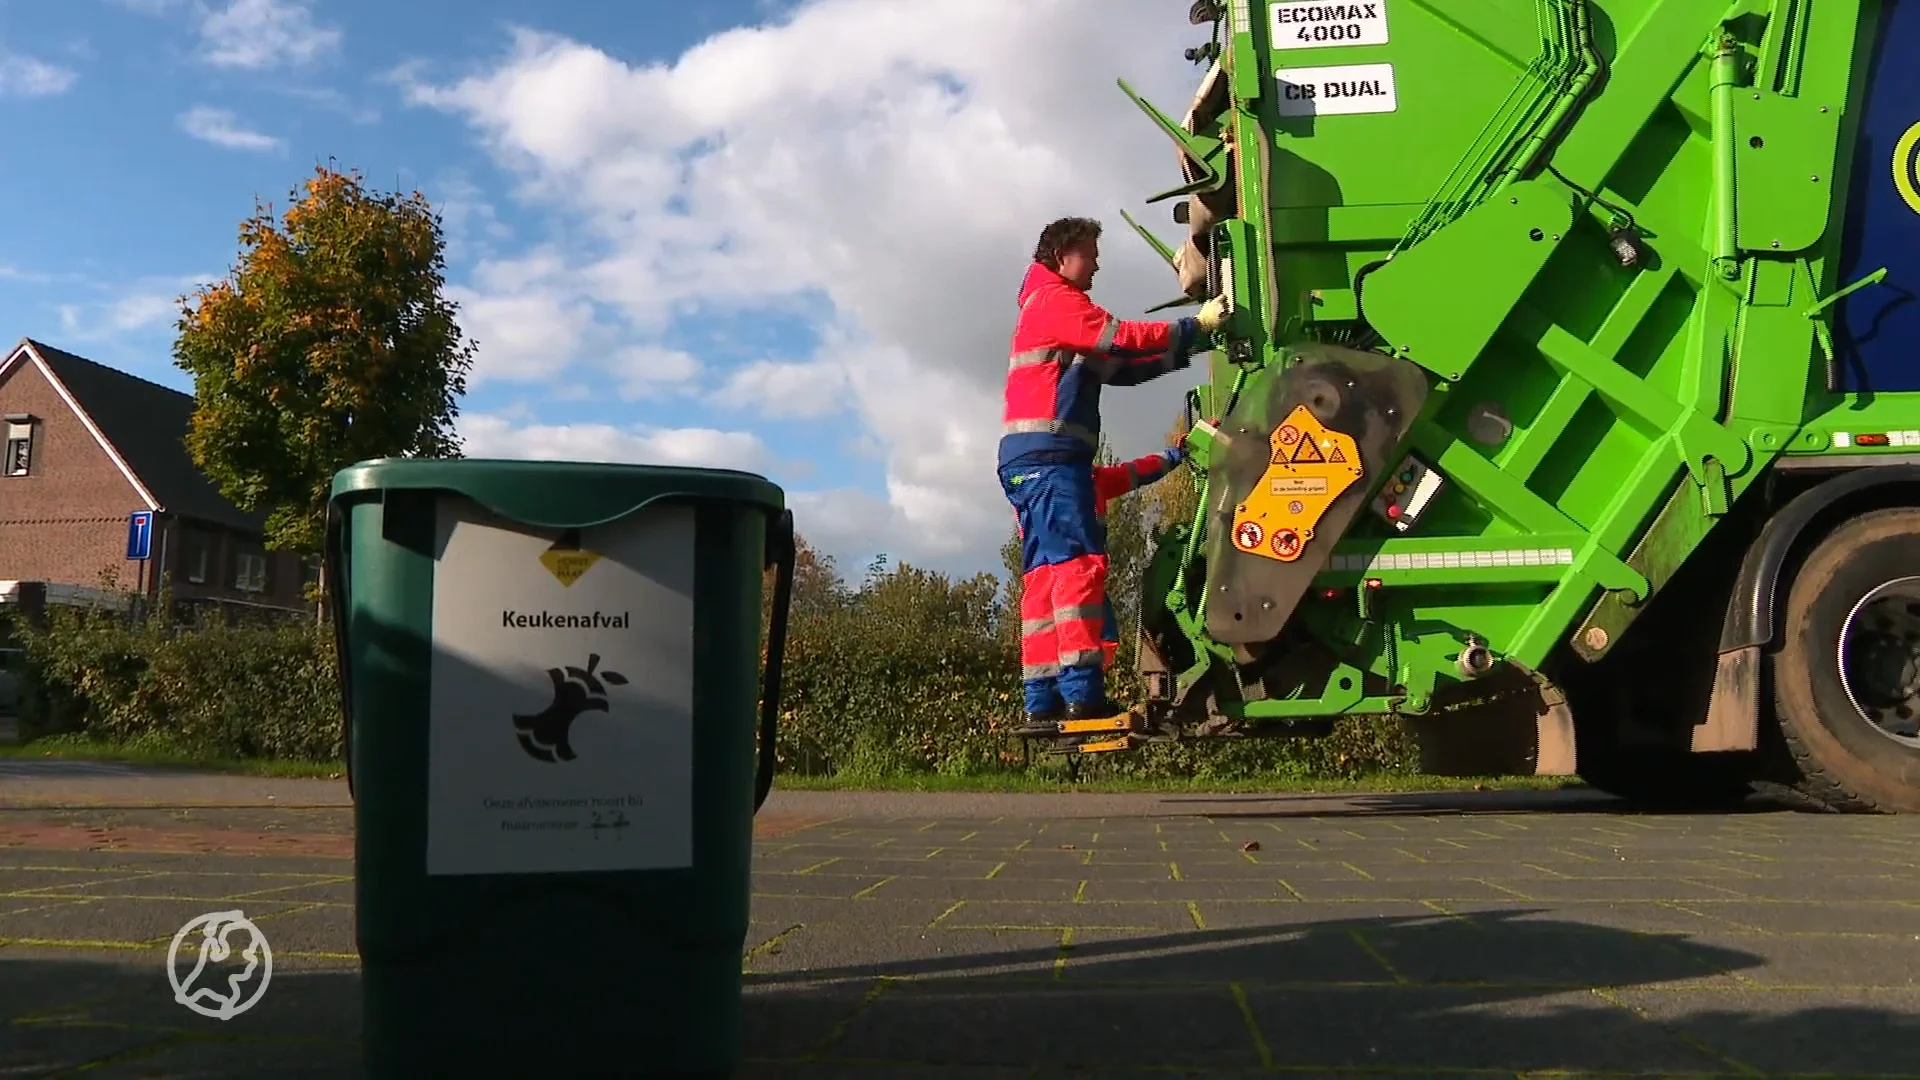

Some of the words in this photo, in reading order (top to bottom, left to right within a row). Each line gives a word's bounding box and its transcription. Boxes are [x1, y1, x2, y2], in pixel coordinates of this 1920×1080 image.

[1278, 3, 1377, 23] ECOMAX
[1297, 24, 1361, 42] 4000
[1285, 83, 1316, 101] CB
[1324, 80, 1386, 98] DUAL
[503, 611, 629, 628] Keukenafval
